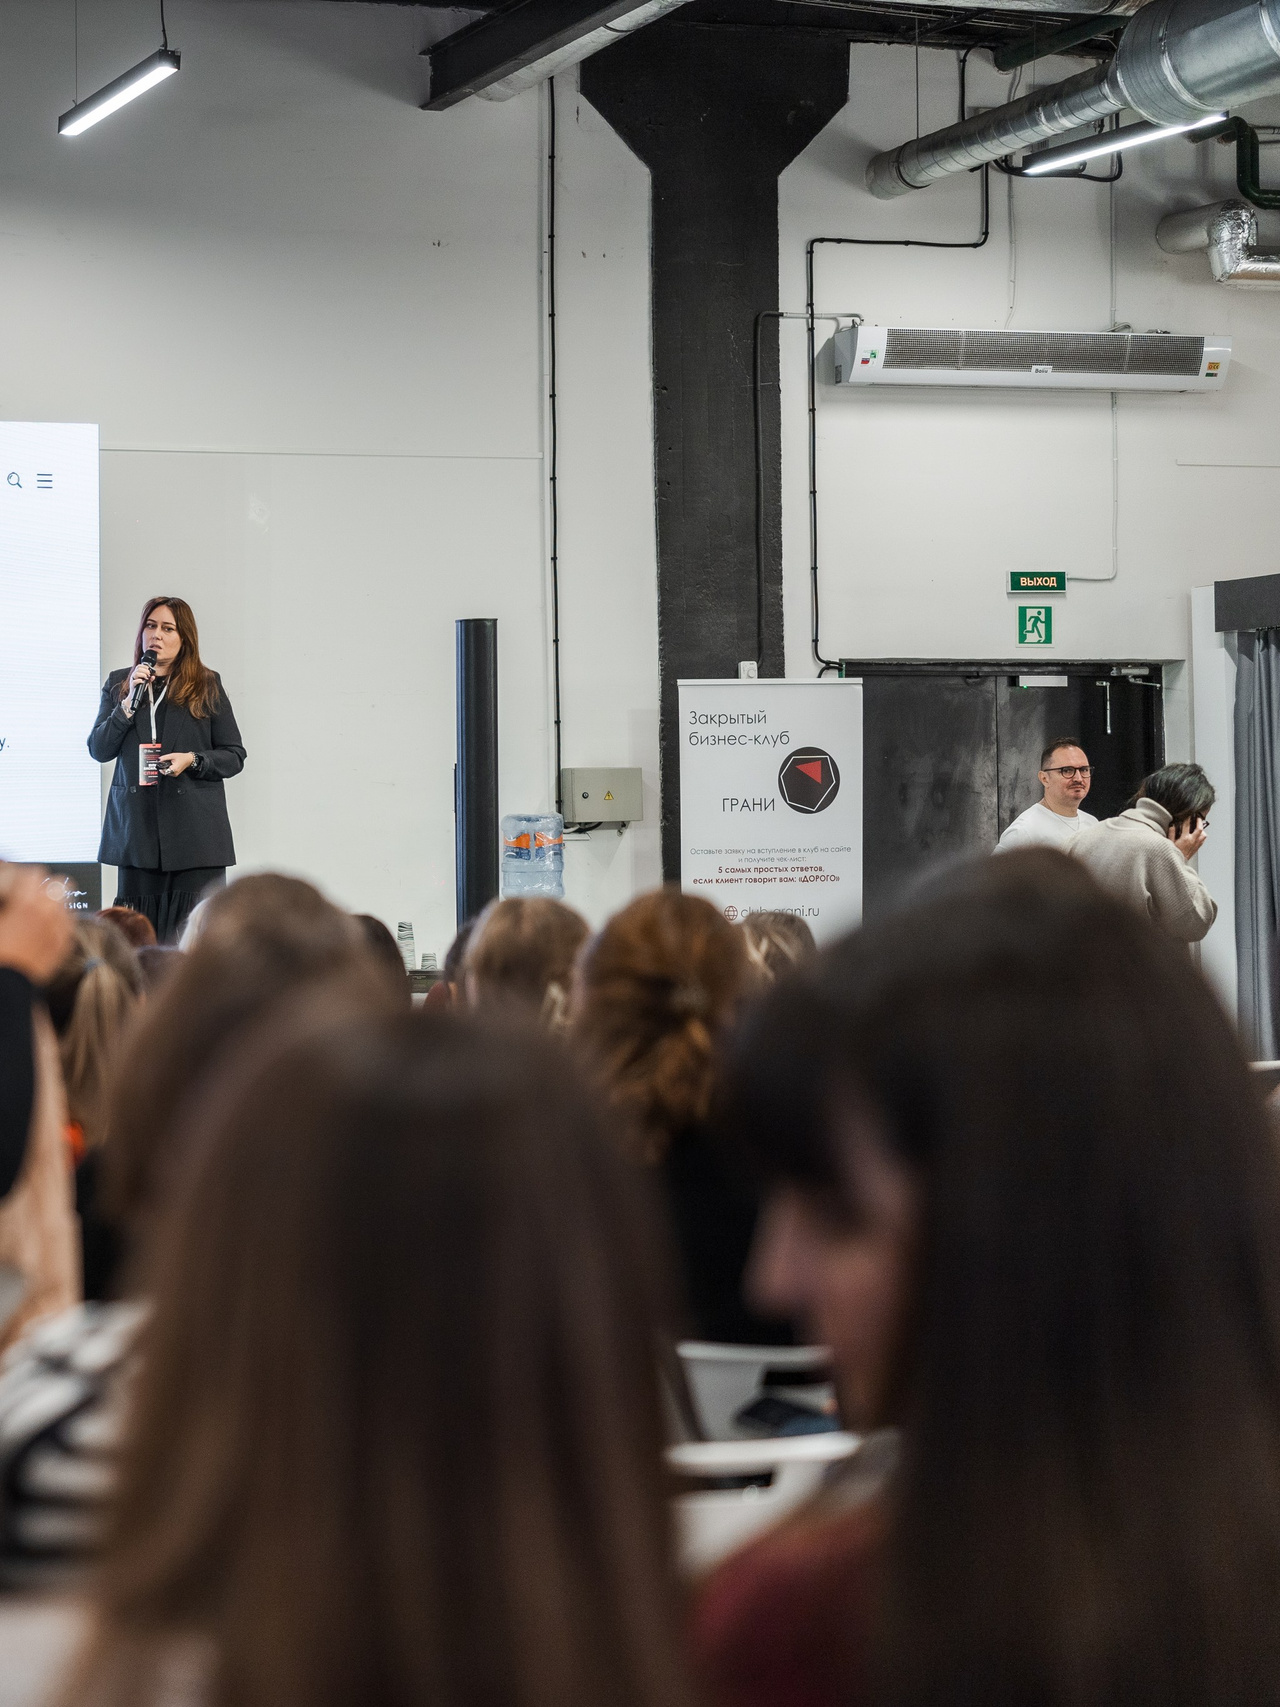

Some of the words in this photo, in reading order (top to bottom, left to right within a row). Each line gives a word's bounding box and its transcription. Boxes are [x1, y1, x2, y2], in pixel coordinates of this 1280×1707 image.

[1020, 577, 1057, 587] ВЫХОД
[688, 709, 767, 728] Закрытый
[688, 730, 790, 749] бизнес-клуб
[722, 797, 775, 812] ГРАНИ
[690, 847, 723, 855] Оставьте
[724, 848, 745, 856] заявку
[757, 848, 796, 856] вступление
[803, 846, 819, 855] клуб
[830, 845, 852, 853] сайте
[725, 866, 752, 874] самых
[753, 866, 789, 874] простых
[692, 877, 713, 885] если
[744, 876, 777, 885] говорит
[798, 874, 840, 883] «ДОРОГО»
